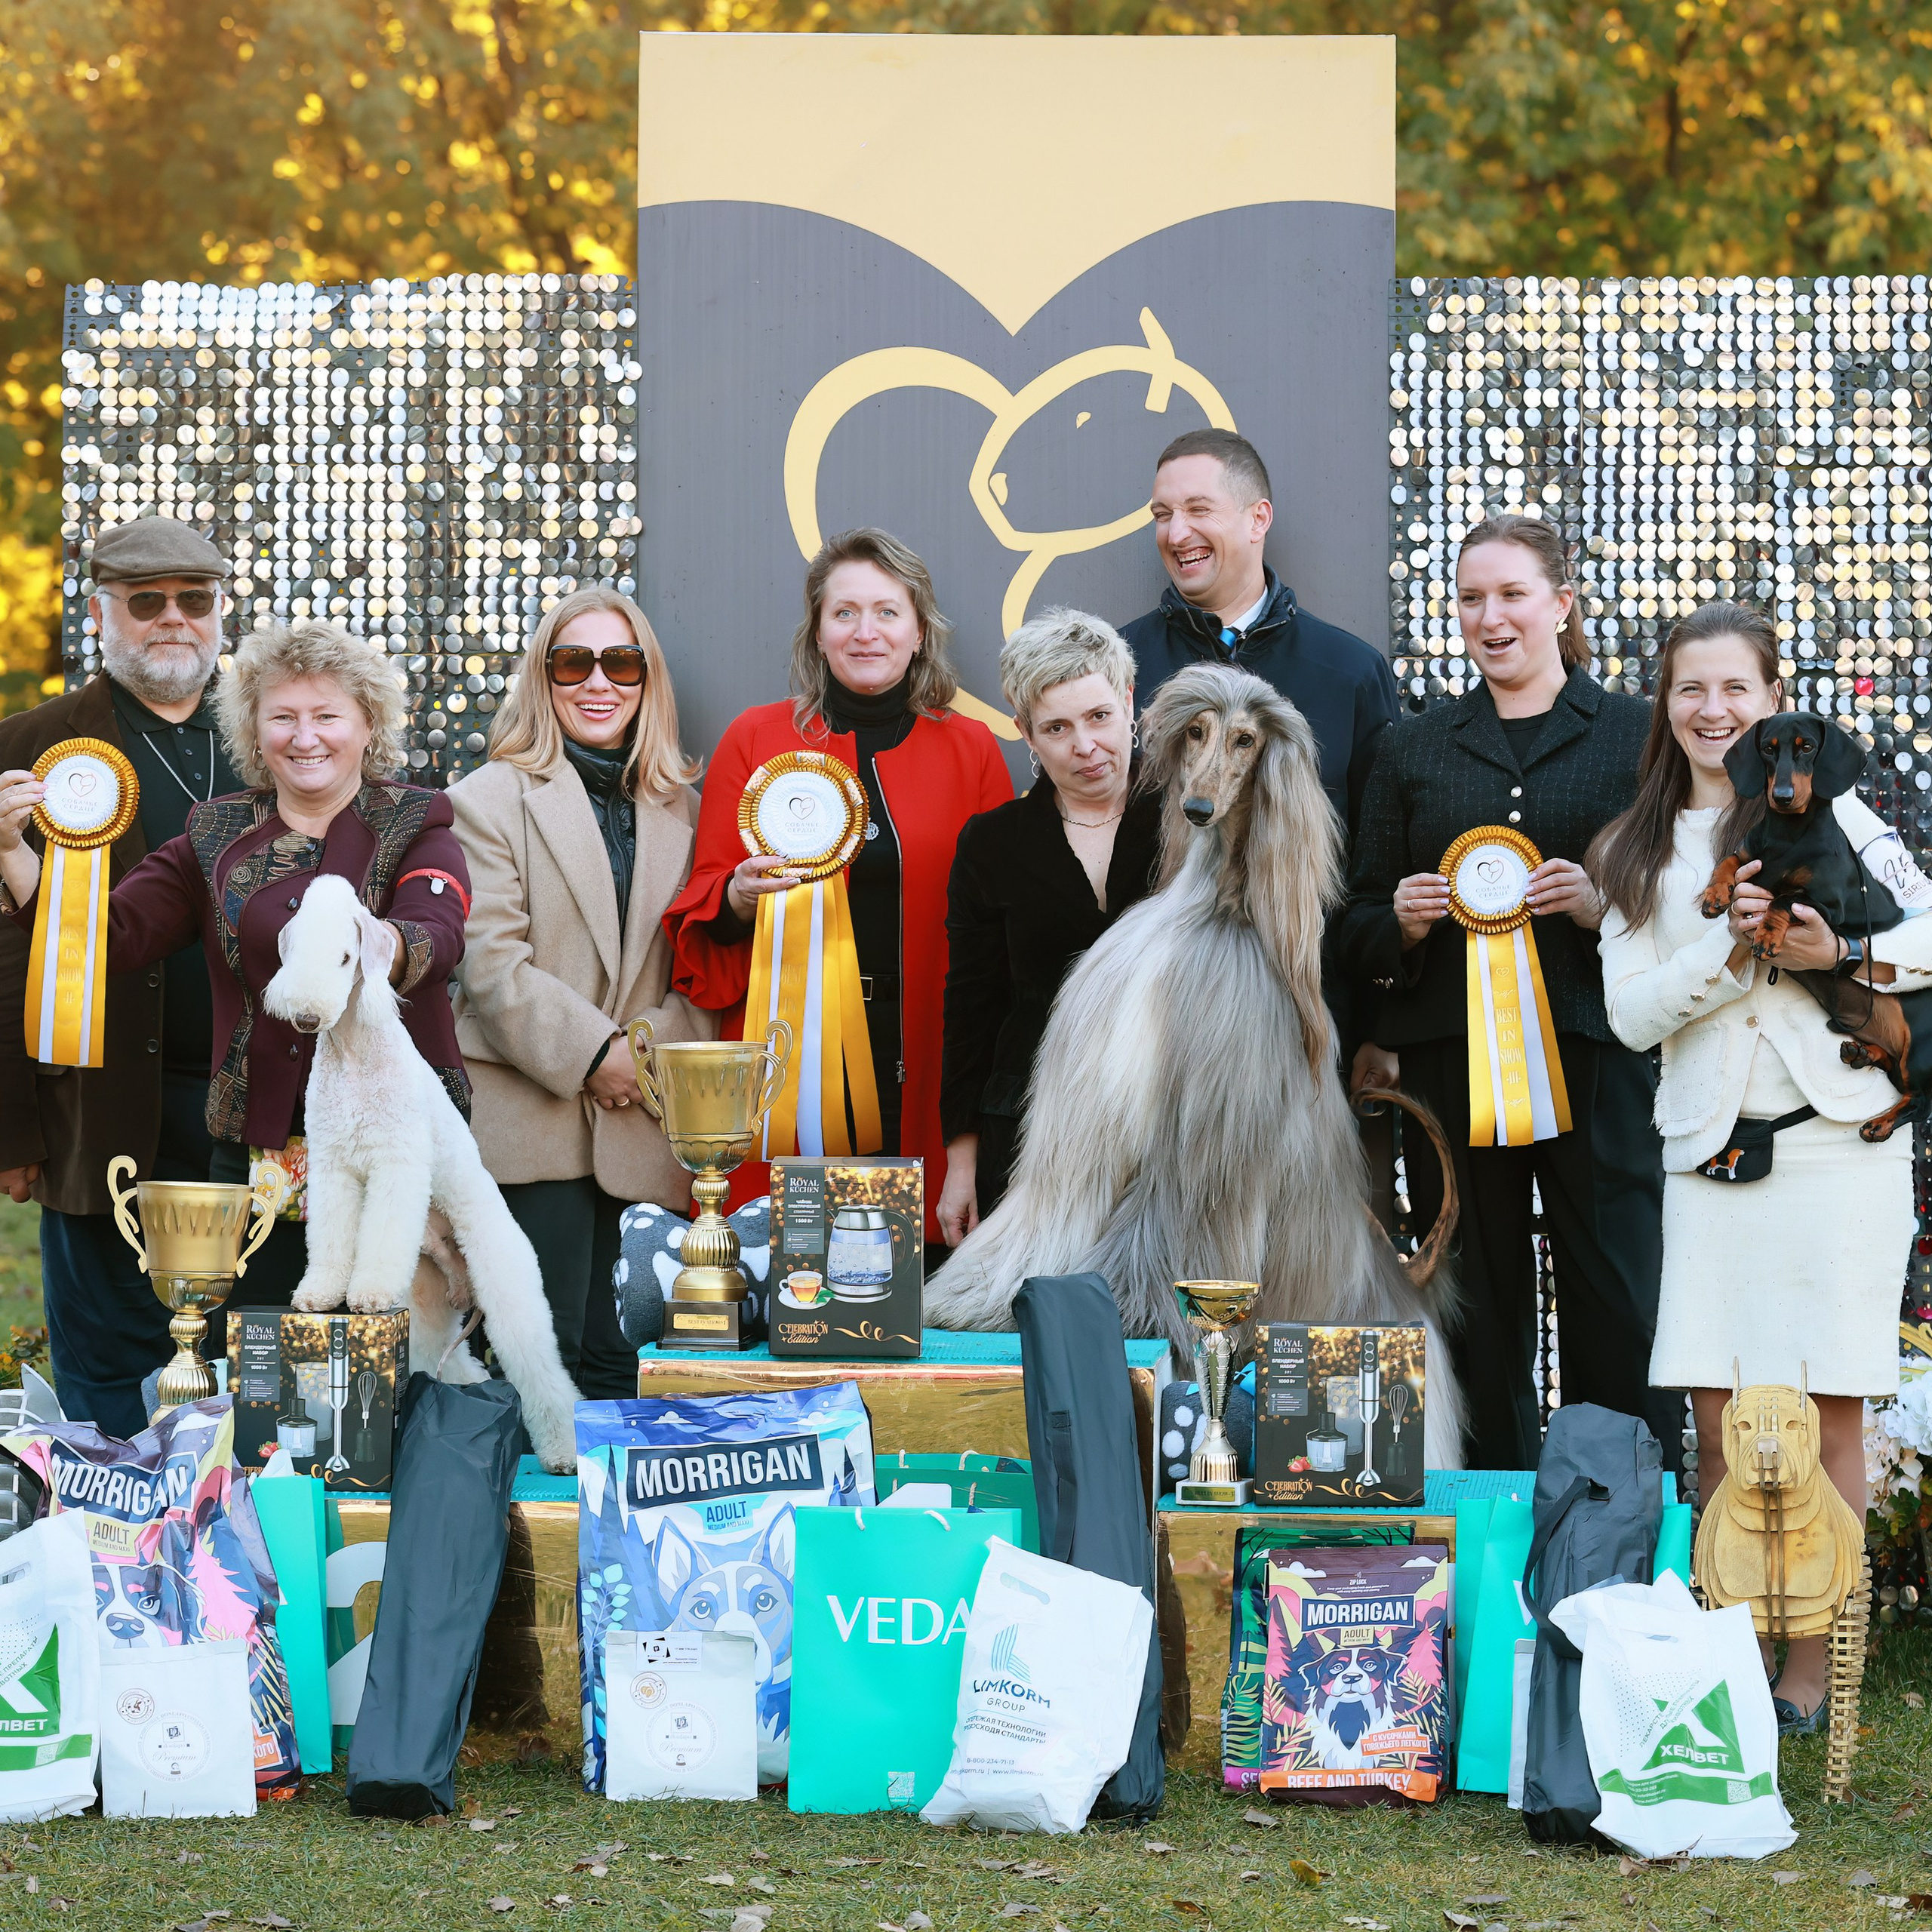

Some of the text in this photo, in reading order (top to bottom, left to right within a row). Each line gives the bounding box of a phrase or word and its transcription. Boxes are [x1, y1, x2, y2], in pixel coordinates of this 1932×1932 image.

[62, 797, 98, 806] СОБАЧЬЕ
[63, 804, 94, 812] СЕРДЦЕ
[1475, 884, 1510, 893] СОБАЧЬЕ
[62, 924, 83, 940] BEST
[65, 947, 79, 960] IN
[60, 967, 82, 984] SHOW
[1495, 1007, 1517, 1023] BEST
[1502, 1029, 1516, 1042] IN
[1499, 1047, 1522, 1065] SHOW
[789, 1177, 820, 1187] ROYAL
[246, 1324, 275, 1334] ROYAL
[778, 1322, 829, 1335] CELEBRATION
[787, 1334, 820, 1344] Edition
[1273, 1338, 1303, 1347] ROYAL
[635, 1442, 812, 1500] MORRIGAN
[51, 1453, 188, 1516] MORRIGAN
[1264, 1480, 1313, 1492] CELEBRATION
[1272, 1491, 1304, 1500] Edition
[706, 1500, 746, 1523] ADULT
[94, 1521, 130, 1545] ADULT
[93, 1539, 109, 1549] MEDIUM
[826, 1595, 971, 1645] VEDA
[1307, 1601, 1408, 1626] MORRIGAN
[1344, 1628, 1371, 1638] ADULT
[973, 1678, 1051, 1709] LIMKORM
[986, 1697, 1026, 1712] GROUP
[0, 1718, 48, 1731] ЛВЕТ
[998, 1719, 1047, 1738] ТЕХНОЛОГИИ
[1001, 1730, 1046, 1744] СТАНДАРТЫ
[1378, 1730, 1417, 1741] КУСОЧКАМИ
[659, 1741, 703, 1753] Premium
[1363, 1740, 1427, 1752] ГОВЯЖЬЕГО ЛЕГКОГО
[152, 1751, 196, 1762] Premium
[966, 1757, 1015, 1765] 8-800-234-71-13
[1660, 1744, 1730, 1765] ХЕЛВЕТ
[1326, 1774, 1355, 1788] AND
[1359, 1773, 1413, 1792] TURKEY
